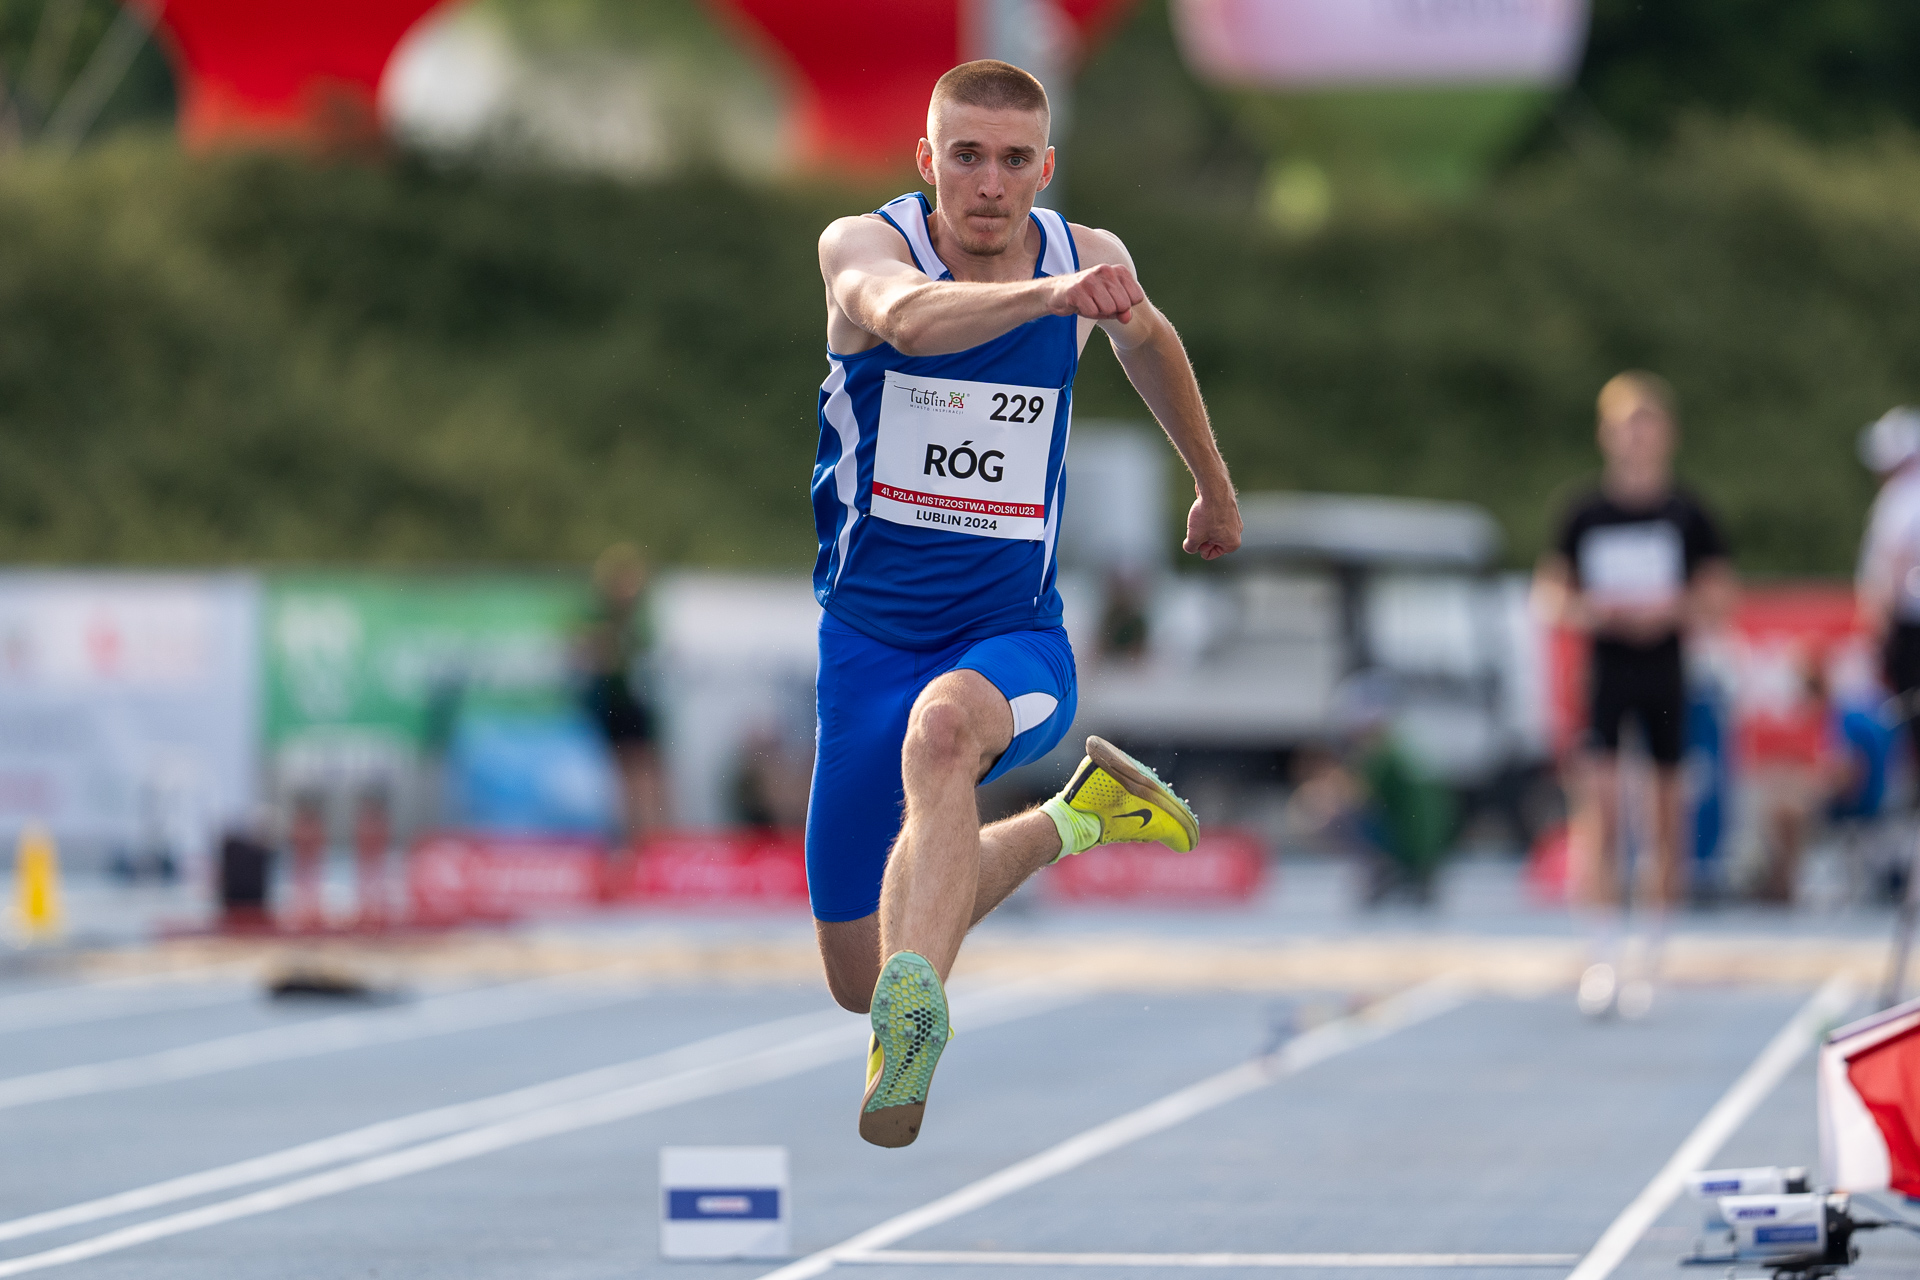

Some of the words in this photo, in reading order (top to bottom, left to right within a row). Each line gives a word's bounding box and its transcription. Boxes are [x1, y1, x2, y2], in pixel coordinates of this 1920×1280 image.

[909, 404, 930, 412] MIASTO
[989, 392, 1045, 424] 229
[923, 440, 1006, 483] RÓG
[880, 487, 892, 497] 41.
[893, 490, 915, 502] PZLA
[916, 496, 986, 512] MISTRZOSTWA
[987, 504, 1018, 515] POLSKI
[1019, 506, 1035, 516] U23
[916, 509, 962, 527] LUBLIN
[964, 516, 998, 531] 2024
